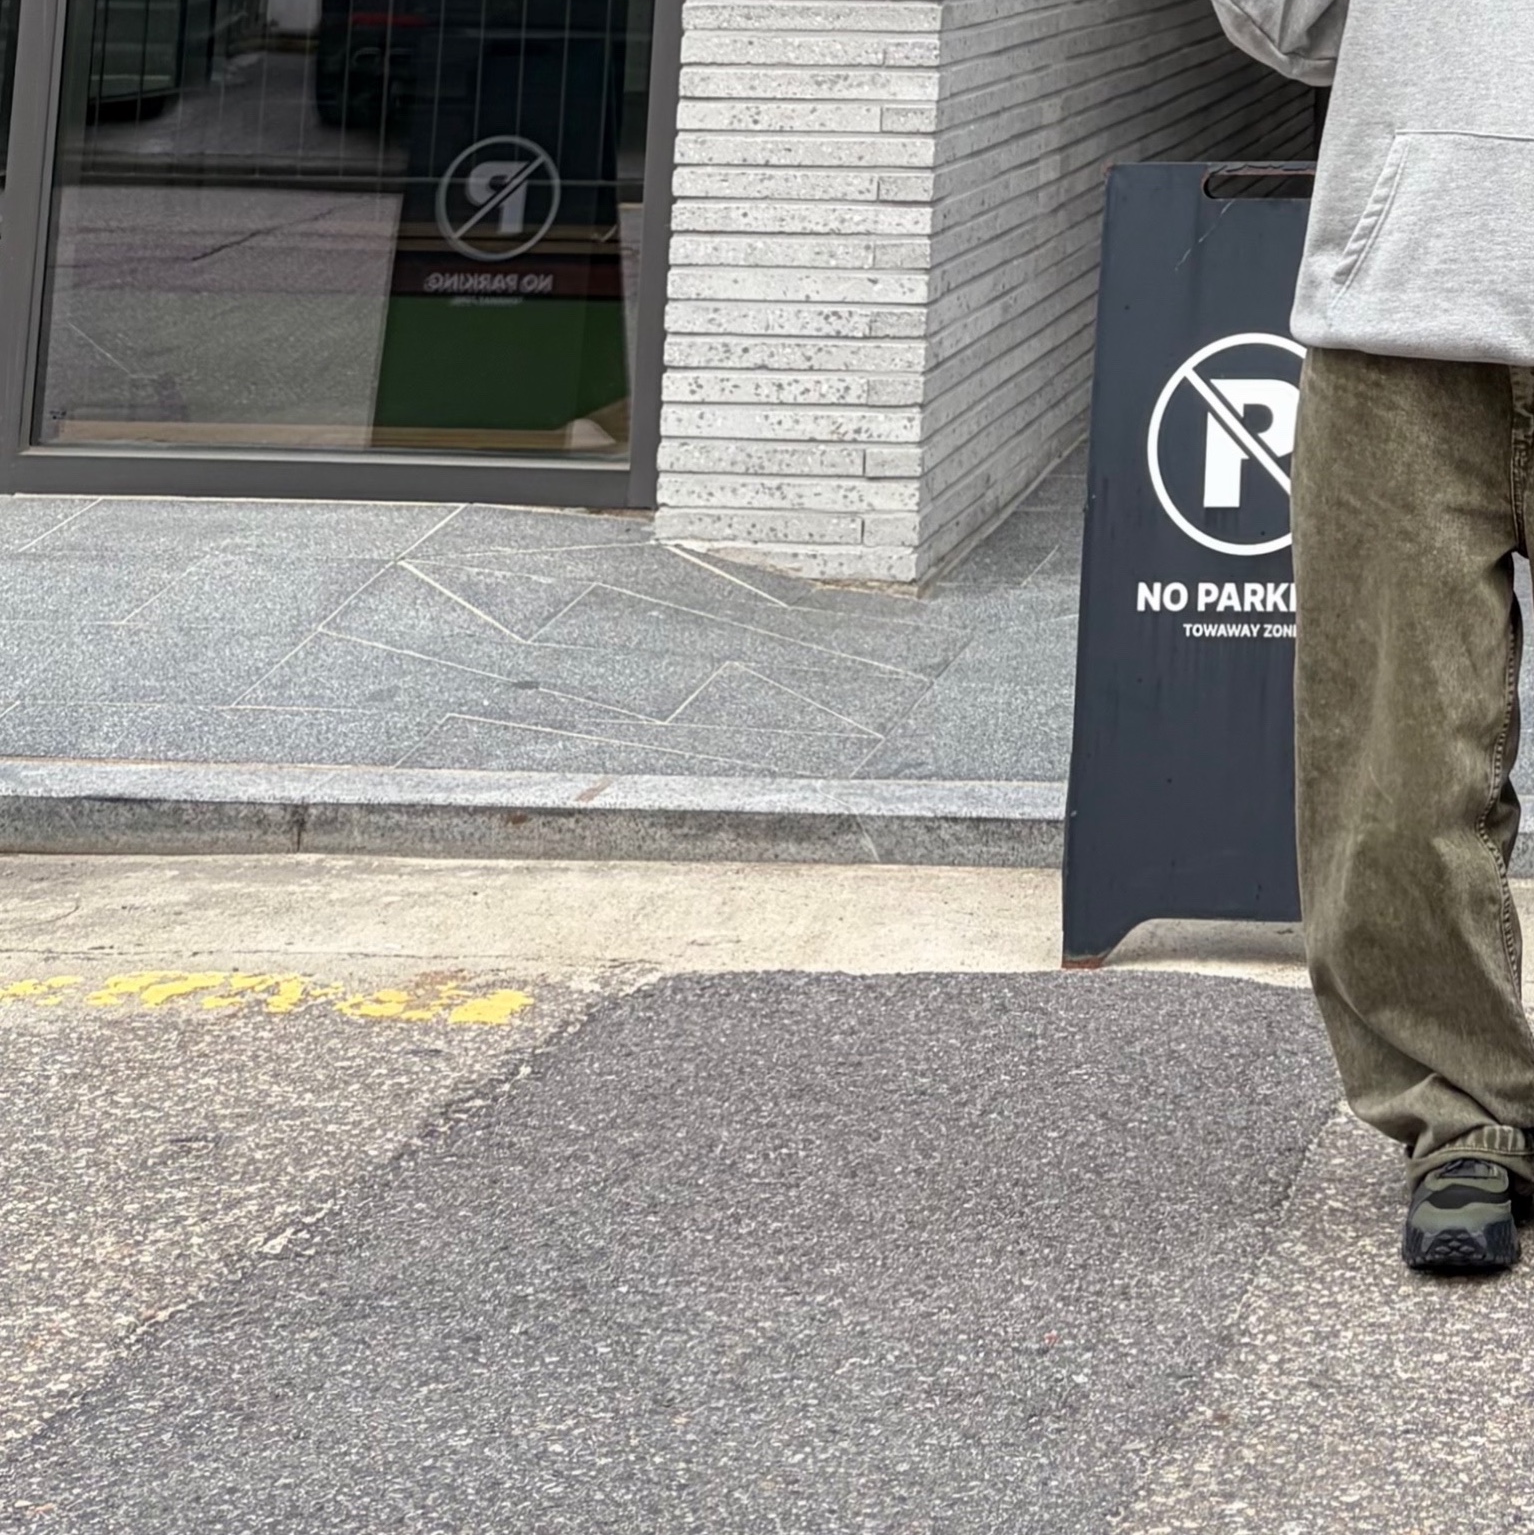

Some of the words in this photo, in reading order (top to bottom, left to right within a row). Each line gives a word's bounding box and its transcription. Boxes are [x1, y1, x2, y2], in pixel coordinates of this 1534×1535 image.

[1136, 581, 1189, 612] NO
[1197, 582, 1297, 612] PARKI
[1183, 623, 1261, 638] TOWAWAY
